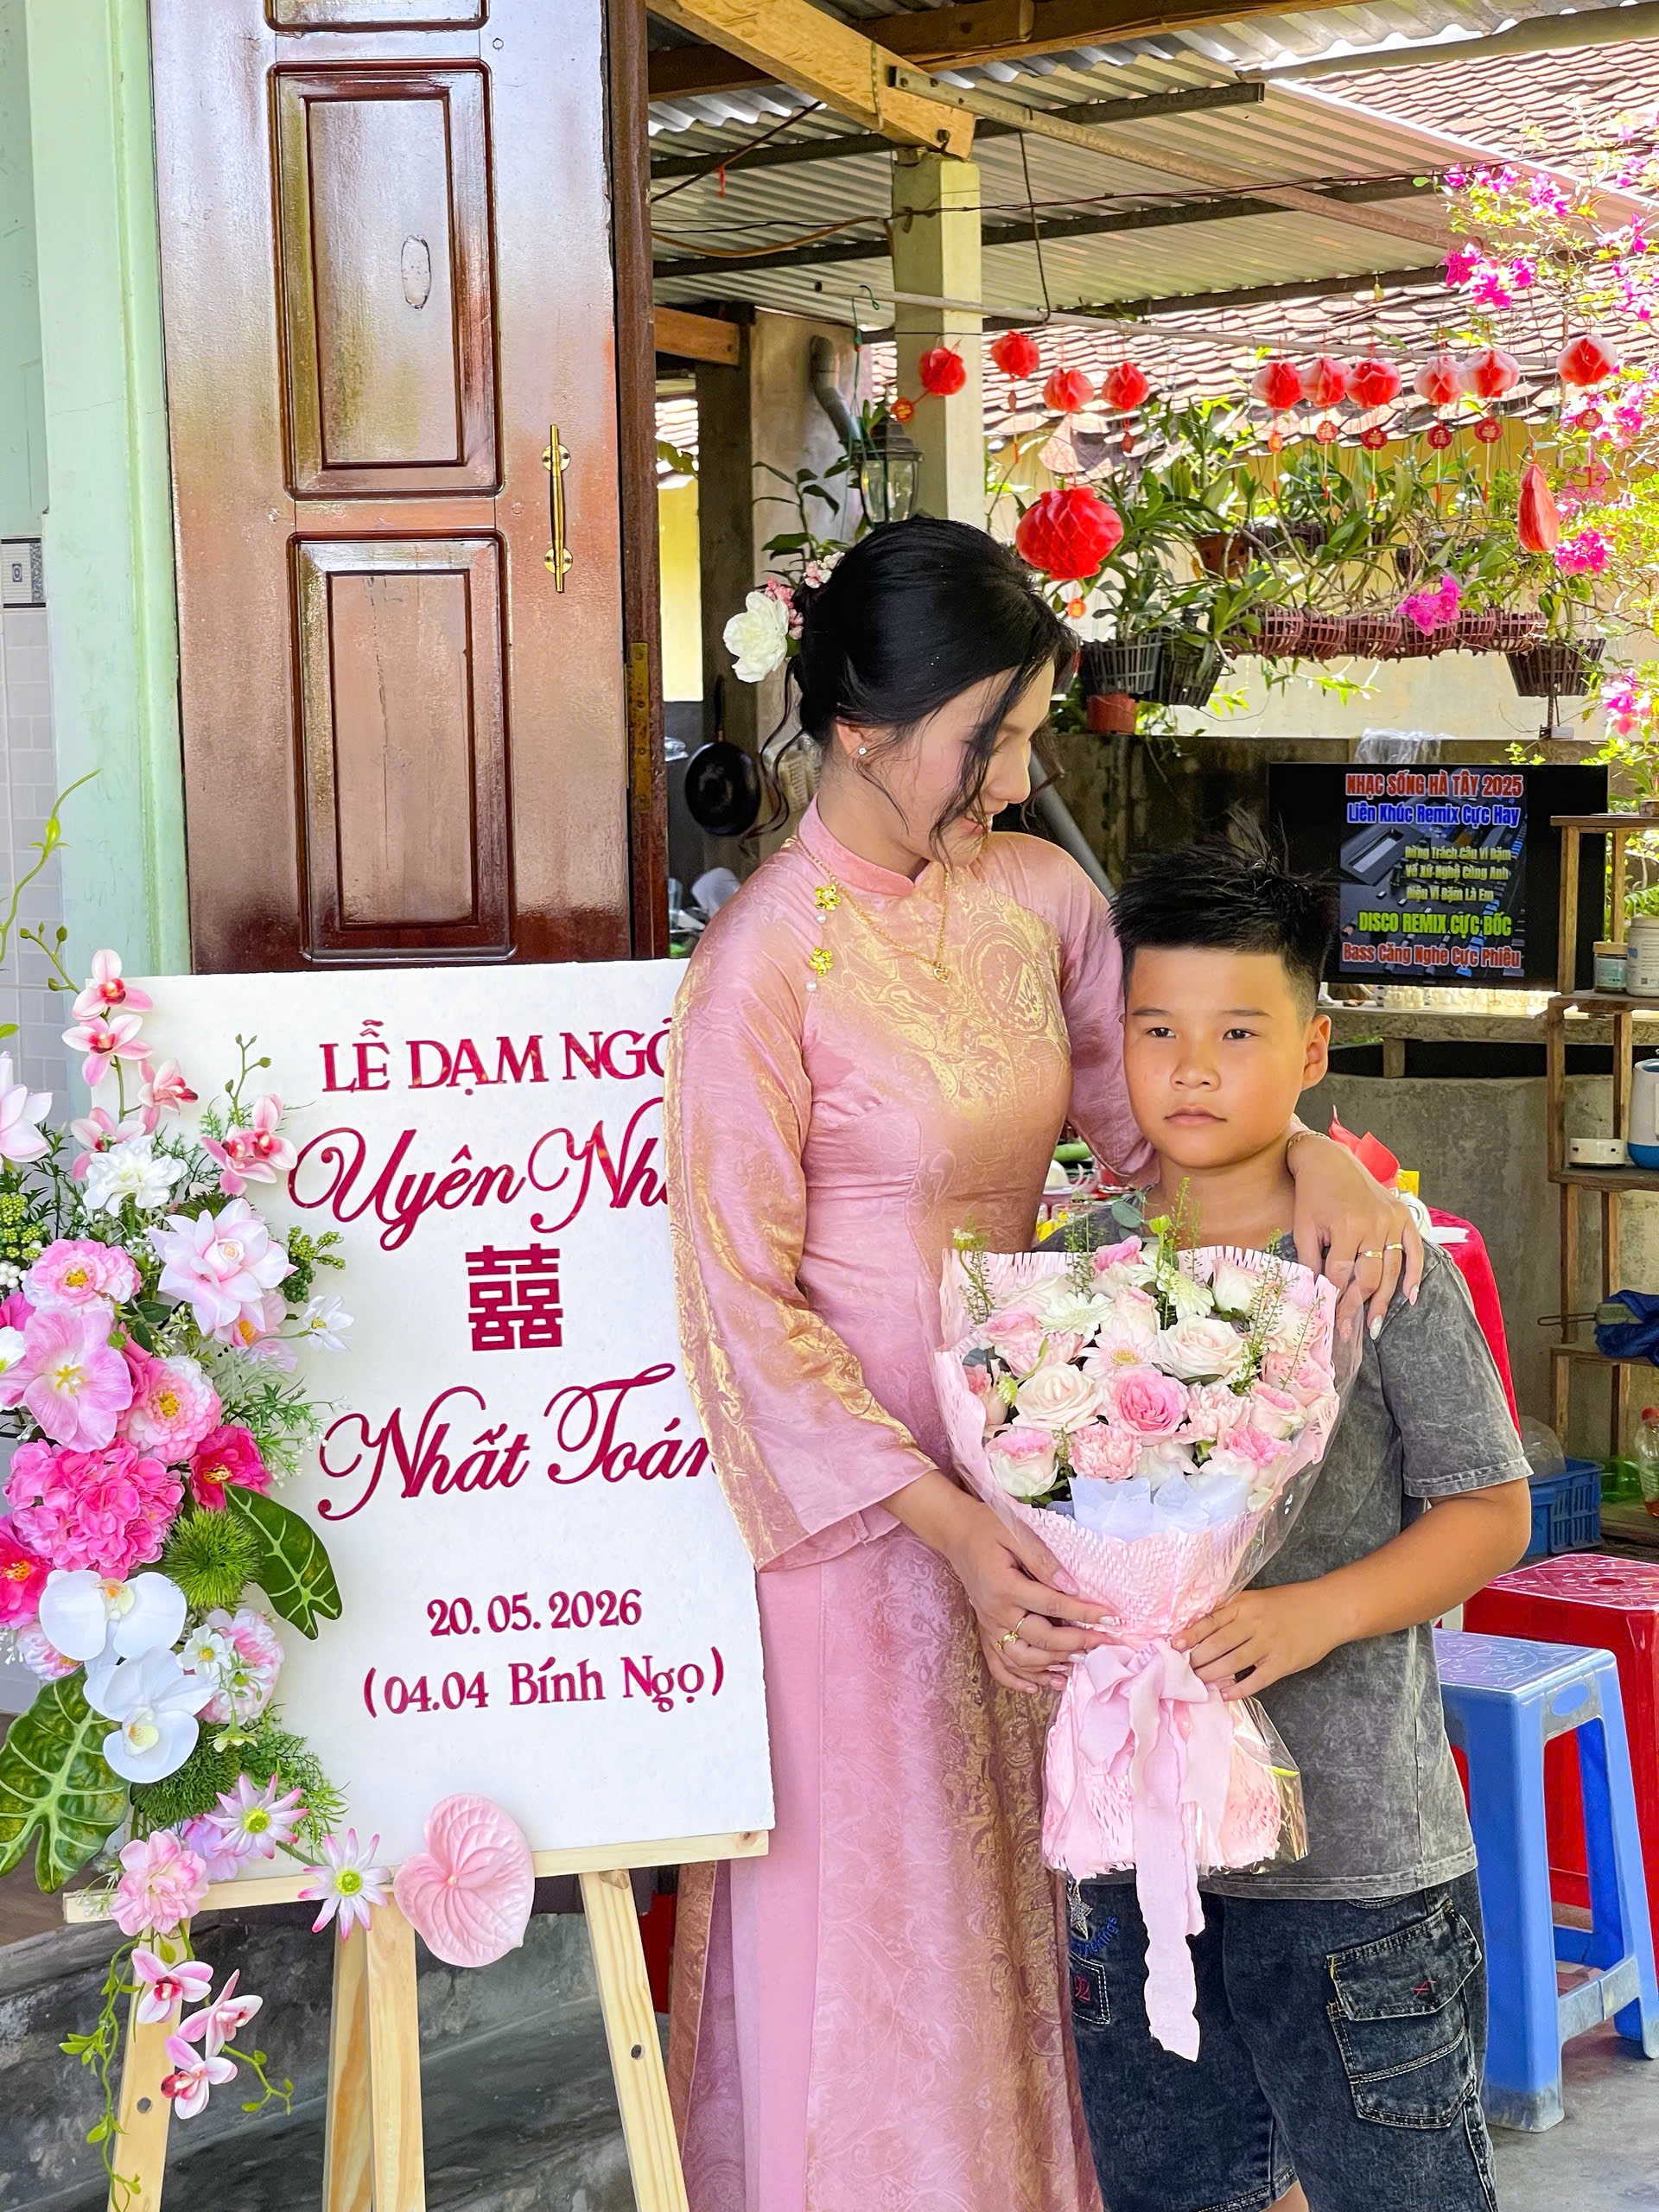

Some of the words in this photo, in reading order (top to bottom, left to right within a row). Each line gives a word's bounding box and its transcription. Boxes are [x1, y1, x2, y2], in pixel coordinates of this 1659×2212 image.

[1345, 773, 1384, 799] NHẠC
[1387, 770, 1425, 796] SỐNG
[1428, 770, 1449, 797] HÀ
[1452, 769, 1479, 798] TÂY
[1482, 774, 1523, 798] 2025
[1347, 801, 1376, 823] Liên
[1378, 802, 1413, 824] Khúc
[1415, 804, 1460, 825] Remix
[1462, 804, 1491, 829] Cực
[1492, 805, 1521, 828] Hay
[1489, 866, 1509, 880] Anh
[1478, 888, 1494, 902] Em
[1358, 912, 1399, 932] DISCO
[1402, 912, 1446, 934] REMIX
[1450, 913, 1480, 939] CỰC
[1484, 912, 1512, 937] BỐC
[1342, 942, 1376, 963] Bass
[1377, 942, 1412, 967] Căng
[1414, 944, 1449, 967] Nghe
[1451, 946, 1478, 968] Cực
[1480, 946, 1522, 968] Phiêu
[321, 1020, 390, 1091] LỄ
[407, 1035, 548, 1095] DẠM
[289, 1127, 525, 1251] Uyên
[528, 1096, 671, 1234] Nh
[318, 1385, 530, 1521] Nhất
[364, 1668, 488, 1719] (04.04
[509, 1656, 604, 1706] Bính
[621, 1647, 724, 1714] Ngọ)
